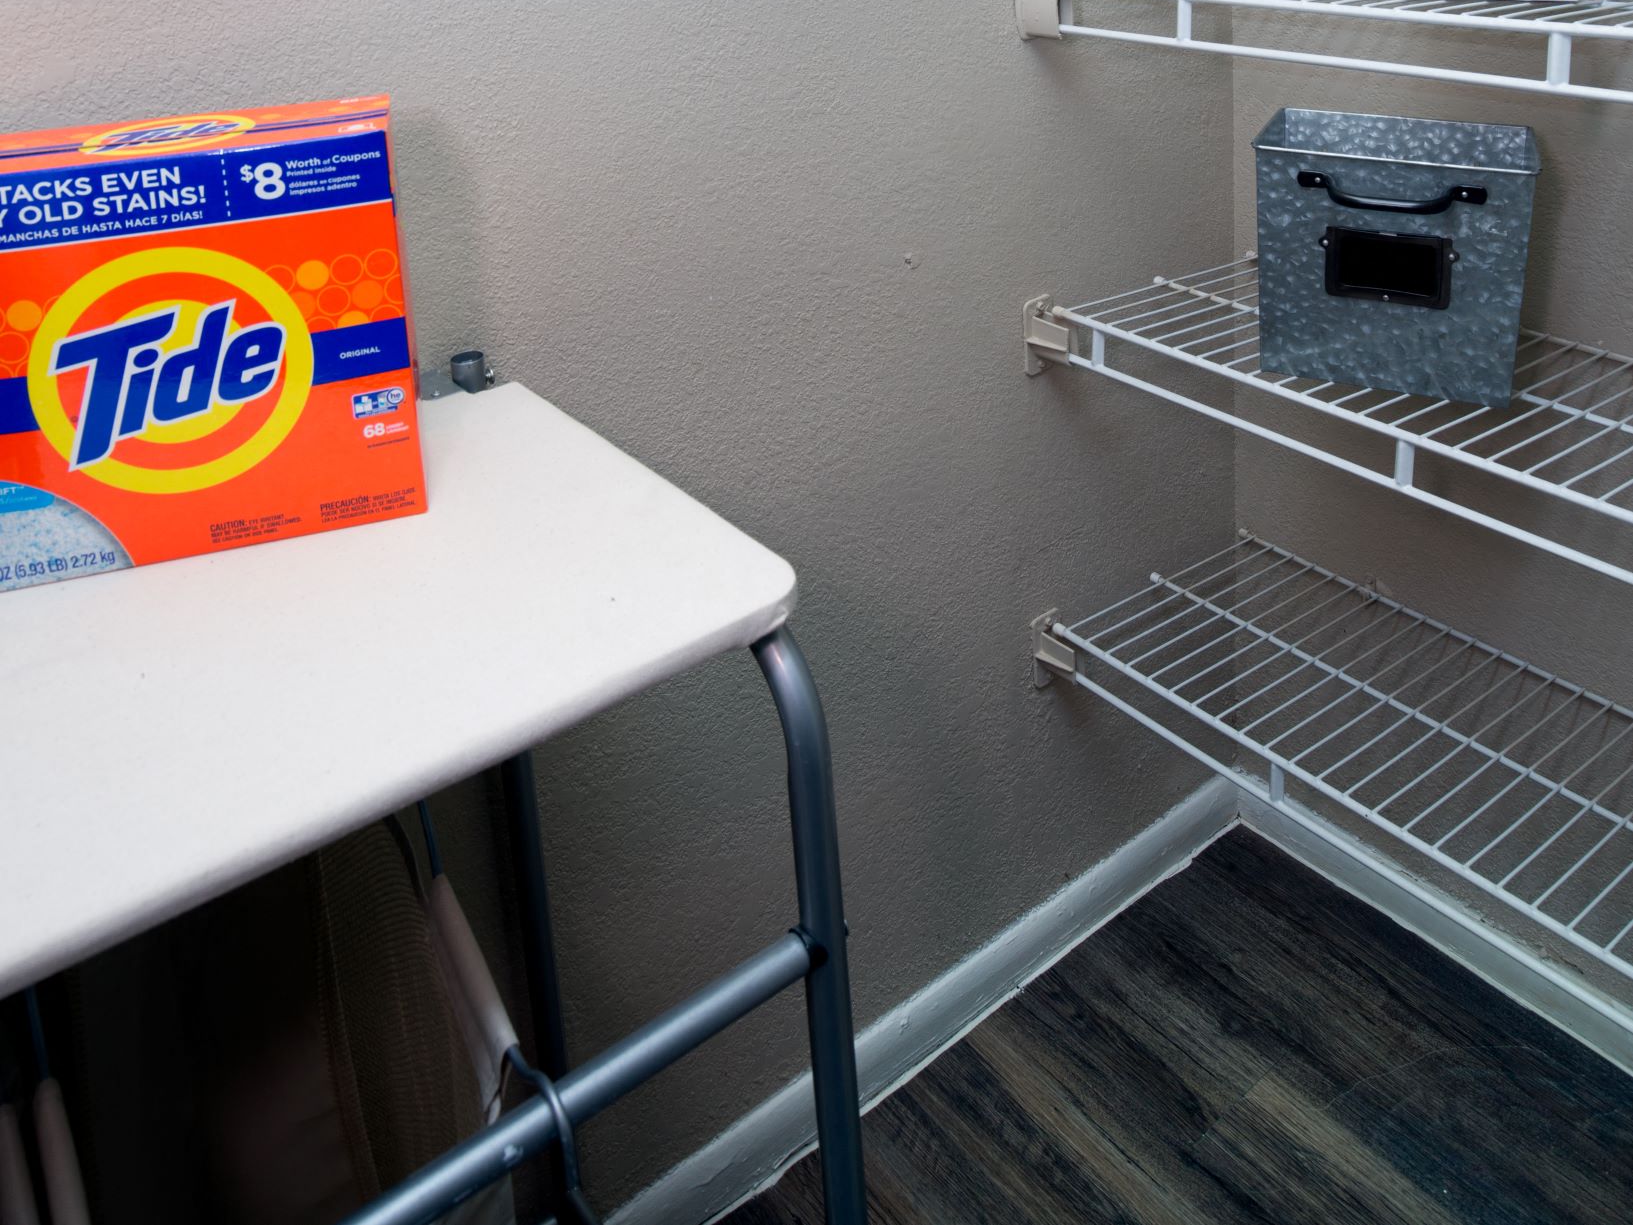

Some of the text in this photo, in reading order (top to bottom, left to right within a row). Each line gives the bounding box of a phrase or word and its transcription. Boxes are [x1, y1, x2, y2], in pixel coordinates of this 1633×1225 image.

[285, 157, 321, 169] Worth
[331, 150, 381, 163] Coupons
[101, 166, 181, 193] EVEN
[286, 165, 337, 177] Printed inside
[327, 173, 360, 185] cupones
[240, 162, 286, 200] $8
[289, 181, 358, 196] impresos adentro
[18, 201, 83, 225] OLD
[92, 185, 206, 216] STAINS!
[62, 225, 79, 236] DE
[82, 222, 122, 233] HASTA
[125, 217, 158, 228] HACE
[161, 215, 168, 223] 7
[171, 210, 203, 222] DÍAS!
[339, 346, 380, 359] ORIGINAL
[47, 298, 287, 472] Tide
[363, 422, 385, 438] 68
[209, 519, 247, 532] CAUTION:
[48, 556, 68, 573] LB)
[70, 553, 97, 569] 2.72
[100, 551, 116, 565] kg
